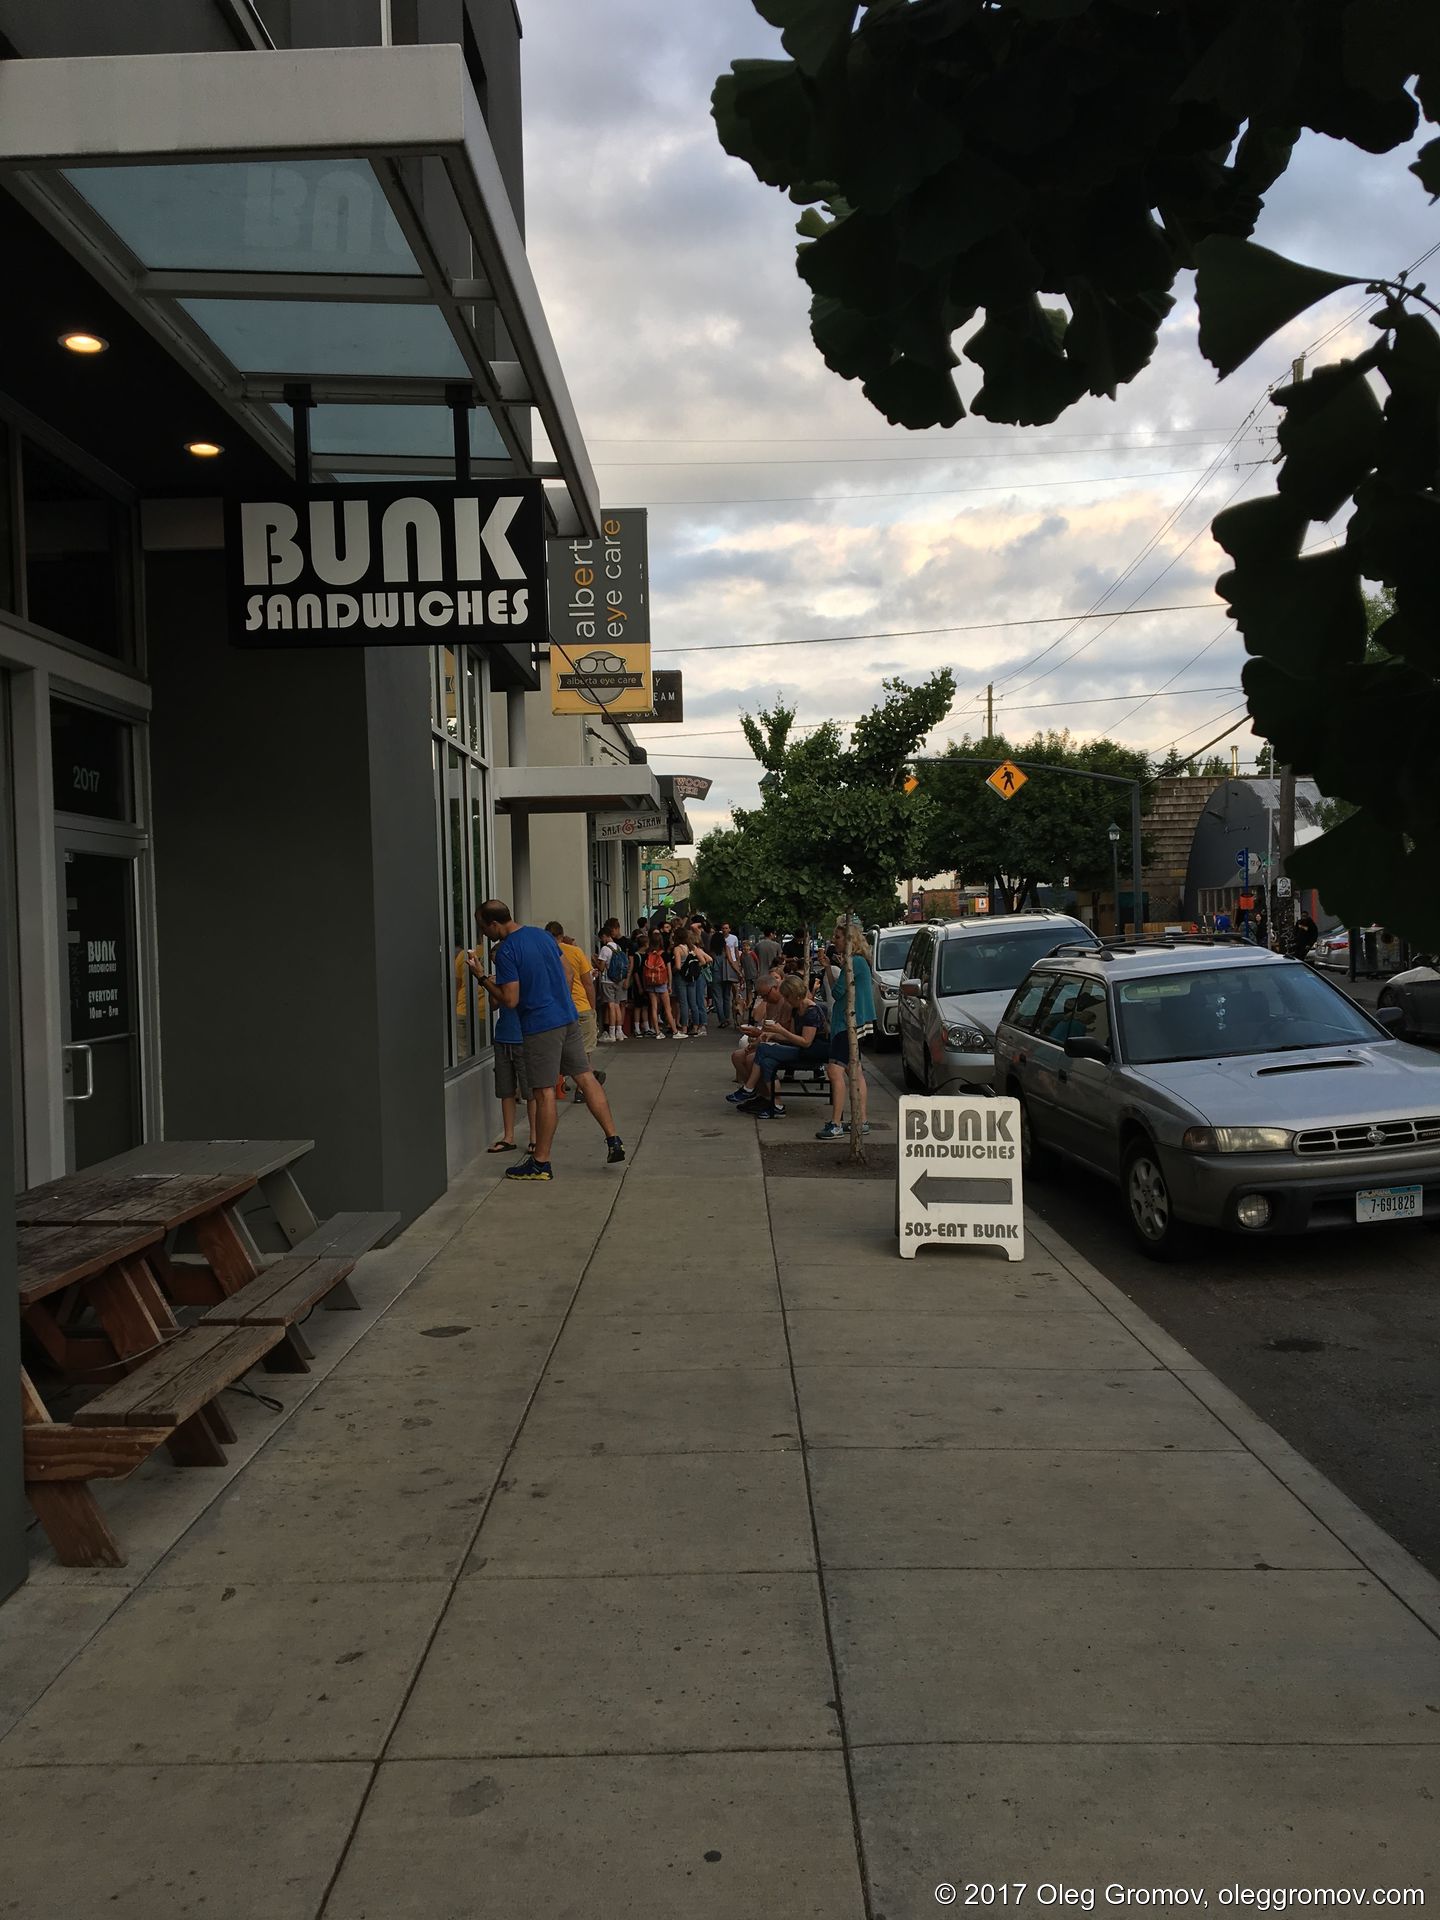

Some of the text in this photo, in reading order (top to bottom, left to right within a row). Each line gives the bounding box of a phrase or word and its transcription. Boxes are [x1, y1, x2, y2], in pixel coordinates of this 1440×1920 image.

[240, 496, 528, 586] BUNK
[568, 539, 596, 638] albert
[604, 519, 628, 637] eye care
[245, 588, 529, 631] SANDWICHES
[600, 677, 615, 686] eye
[617, 676, 637, 684] care
[73, 766, 100, 792] 2017
[602, 816, 661, 836] SALT & STRAW
[87, 940, 116, 962] BUNK
[88, 989, 118, 1003] EVERYDAY
[905, 1109, 1015, 1142] BUNK
[905, 1144, 1015, 1160] SANDWICHES
[904, 1222, 1019, 1239] 503-EAT BUNK
